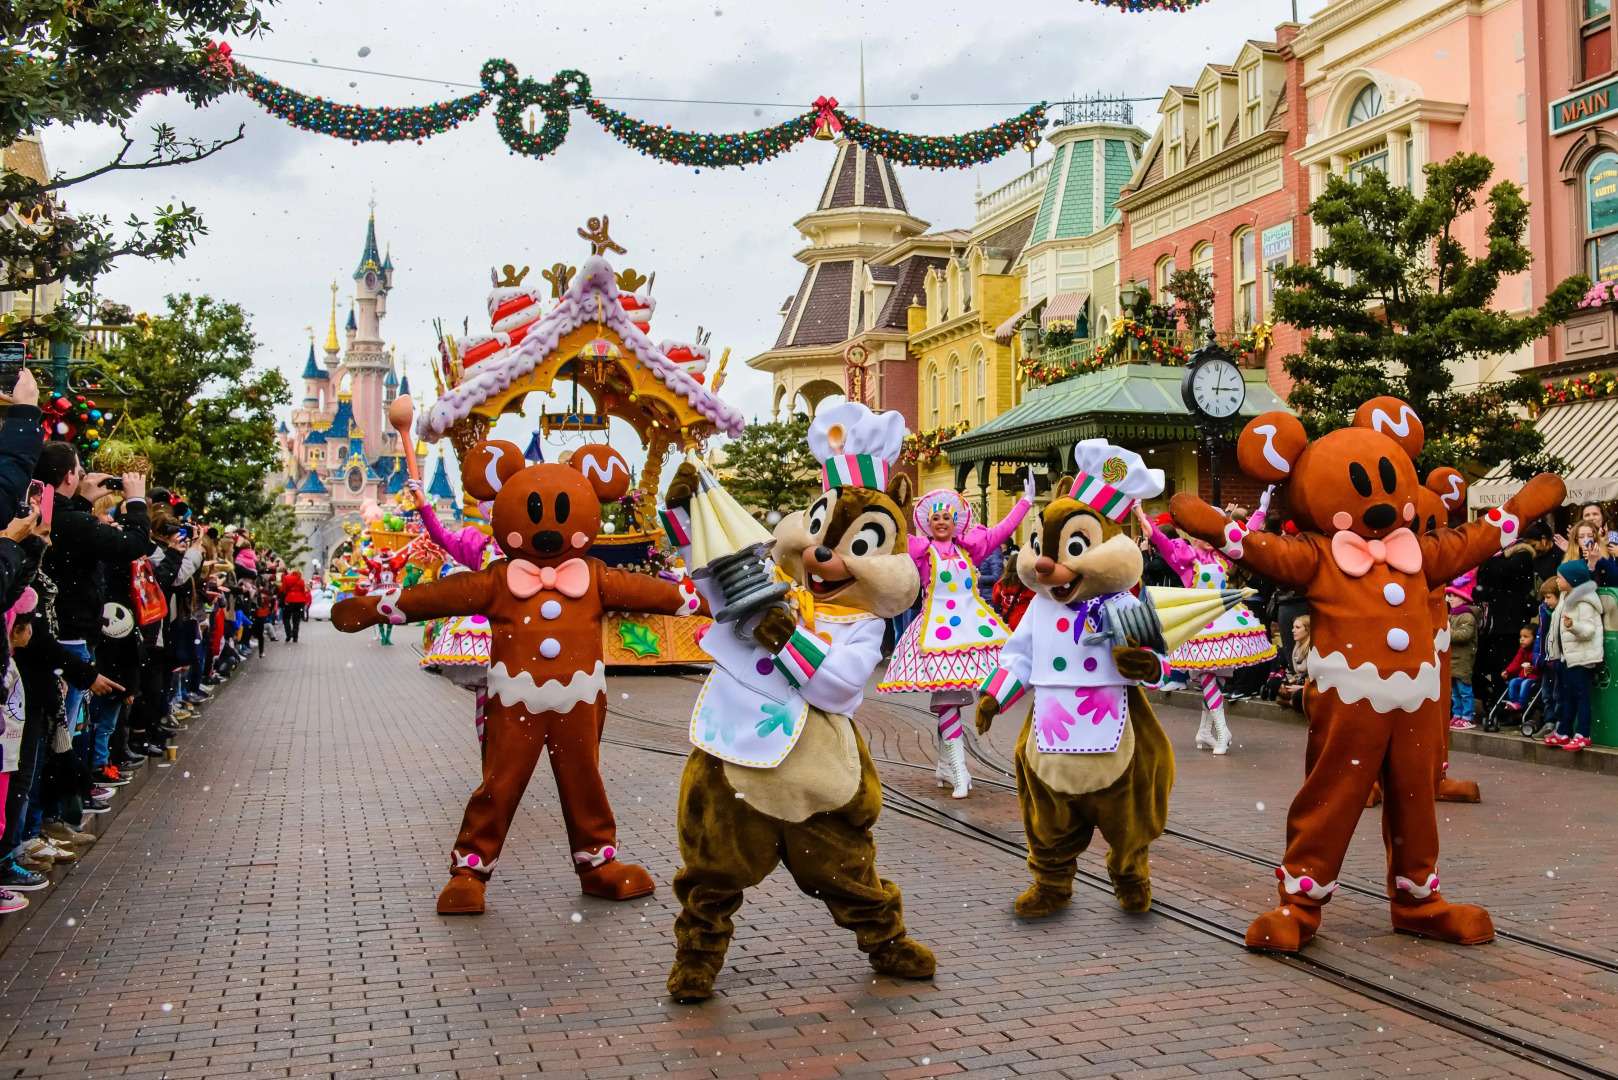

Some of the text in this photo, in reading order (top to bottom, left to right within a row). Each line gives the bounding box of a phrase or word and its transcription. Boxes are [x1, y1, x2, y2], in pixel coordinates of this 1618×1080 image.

[1562, 90, 1609, 124] MAIN
[1595, 183, 1617, 198] GAZETTE
[1275, 230, 1291, 240] GAME
[1264, 239, 1291, 257] HALMA
[1479, 494, 1497, 503] FINE
